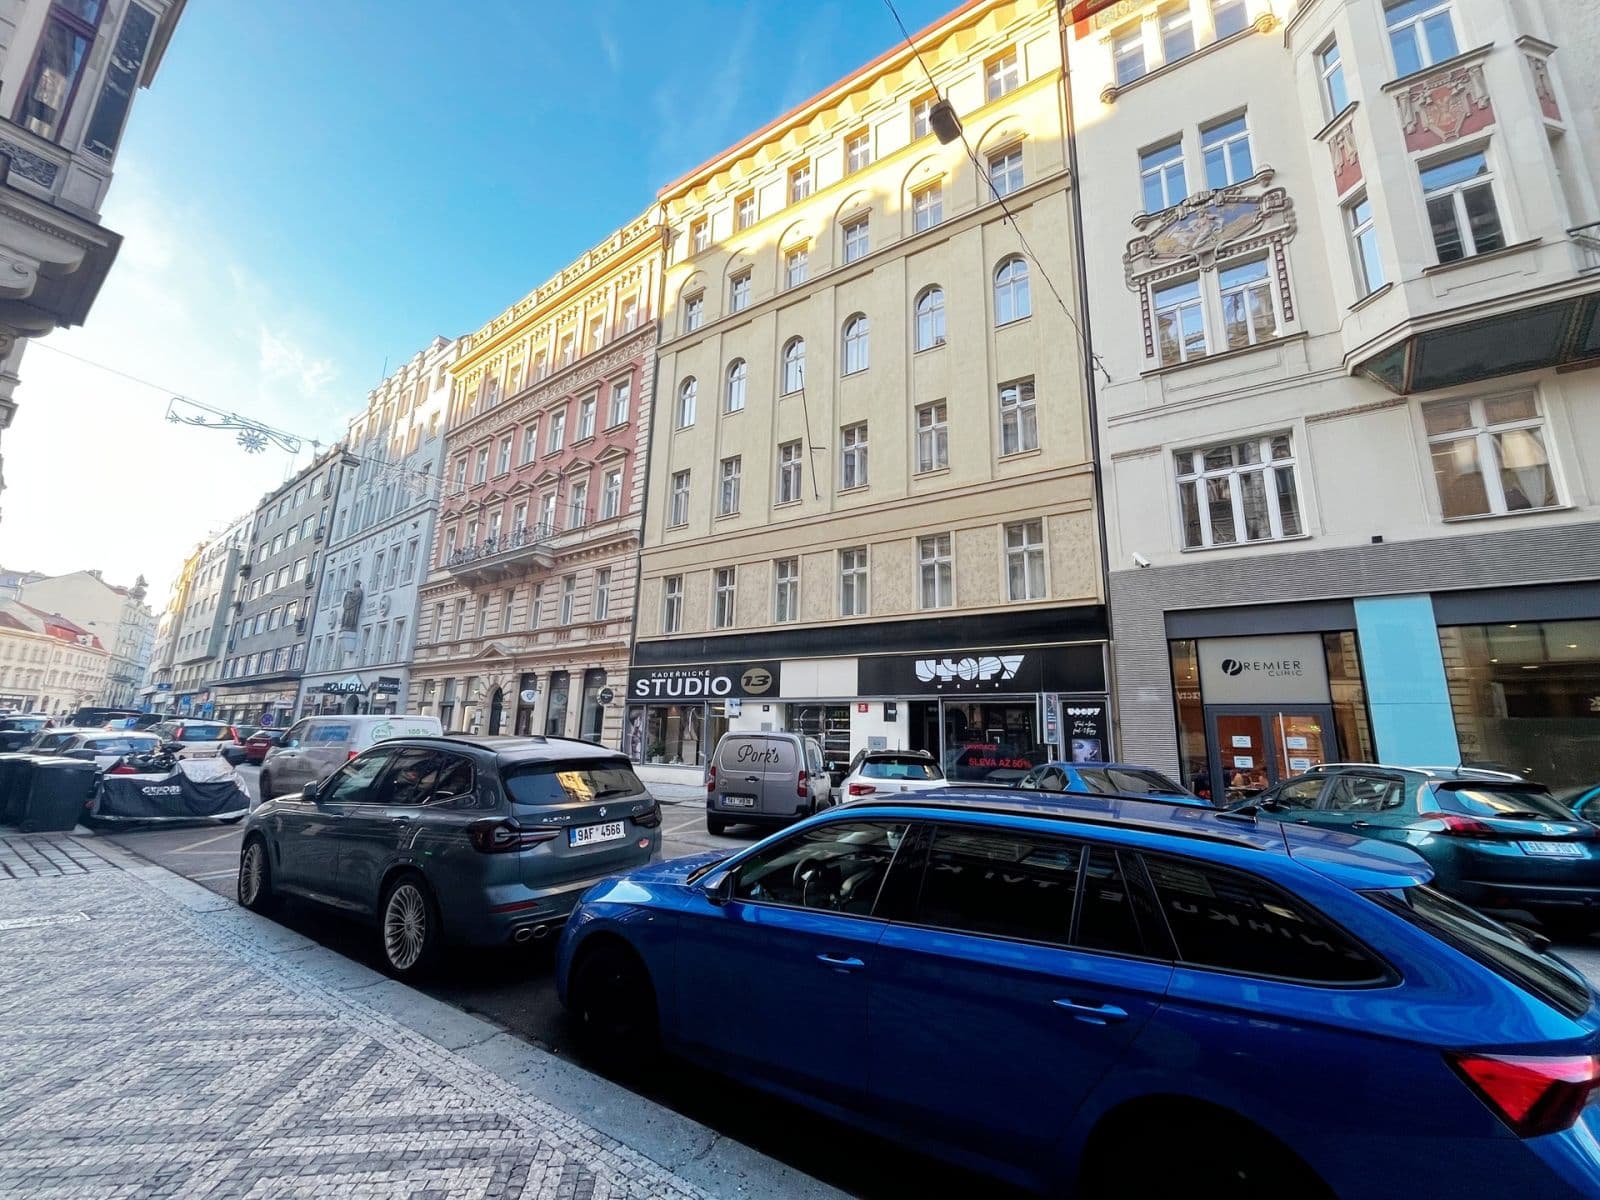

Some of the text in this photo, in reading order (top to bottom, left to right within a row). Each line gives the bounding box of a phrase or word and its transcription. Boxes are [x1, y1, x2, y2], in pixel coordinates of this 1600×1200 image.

[651, 669, 711, 678] KADEŘNICKÉ
[1221, 658, 1301, 676] PREMIER
[635, 676, 732, 696] STUDIO
[743, 675, 770, 687] 13
[737, 744, 779, 764] Pork's
[968, 758, 997, 767] SLEVA
[577, 827, 594, 841] 9AF
